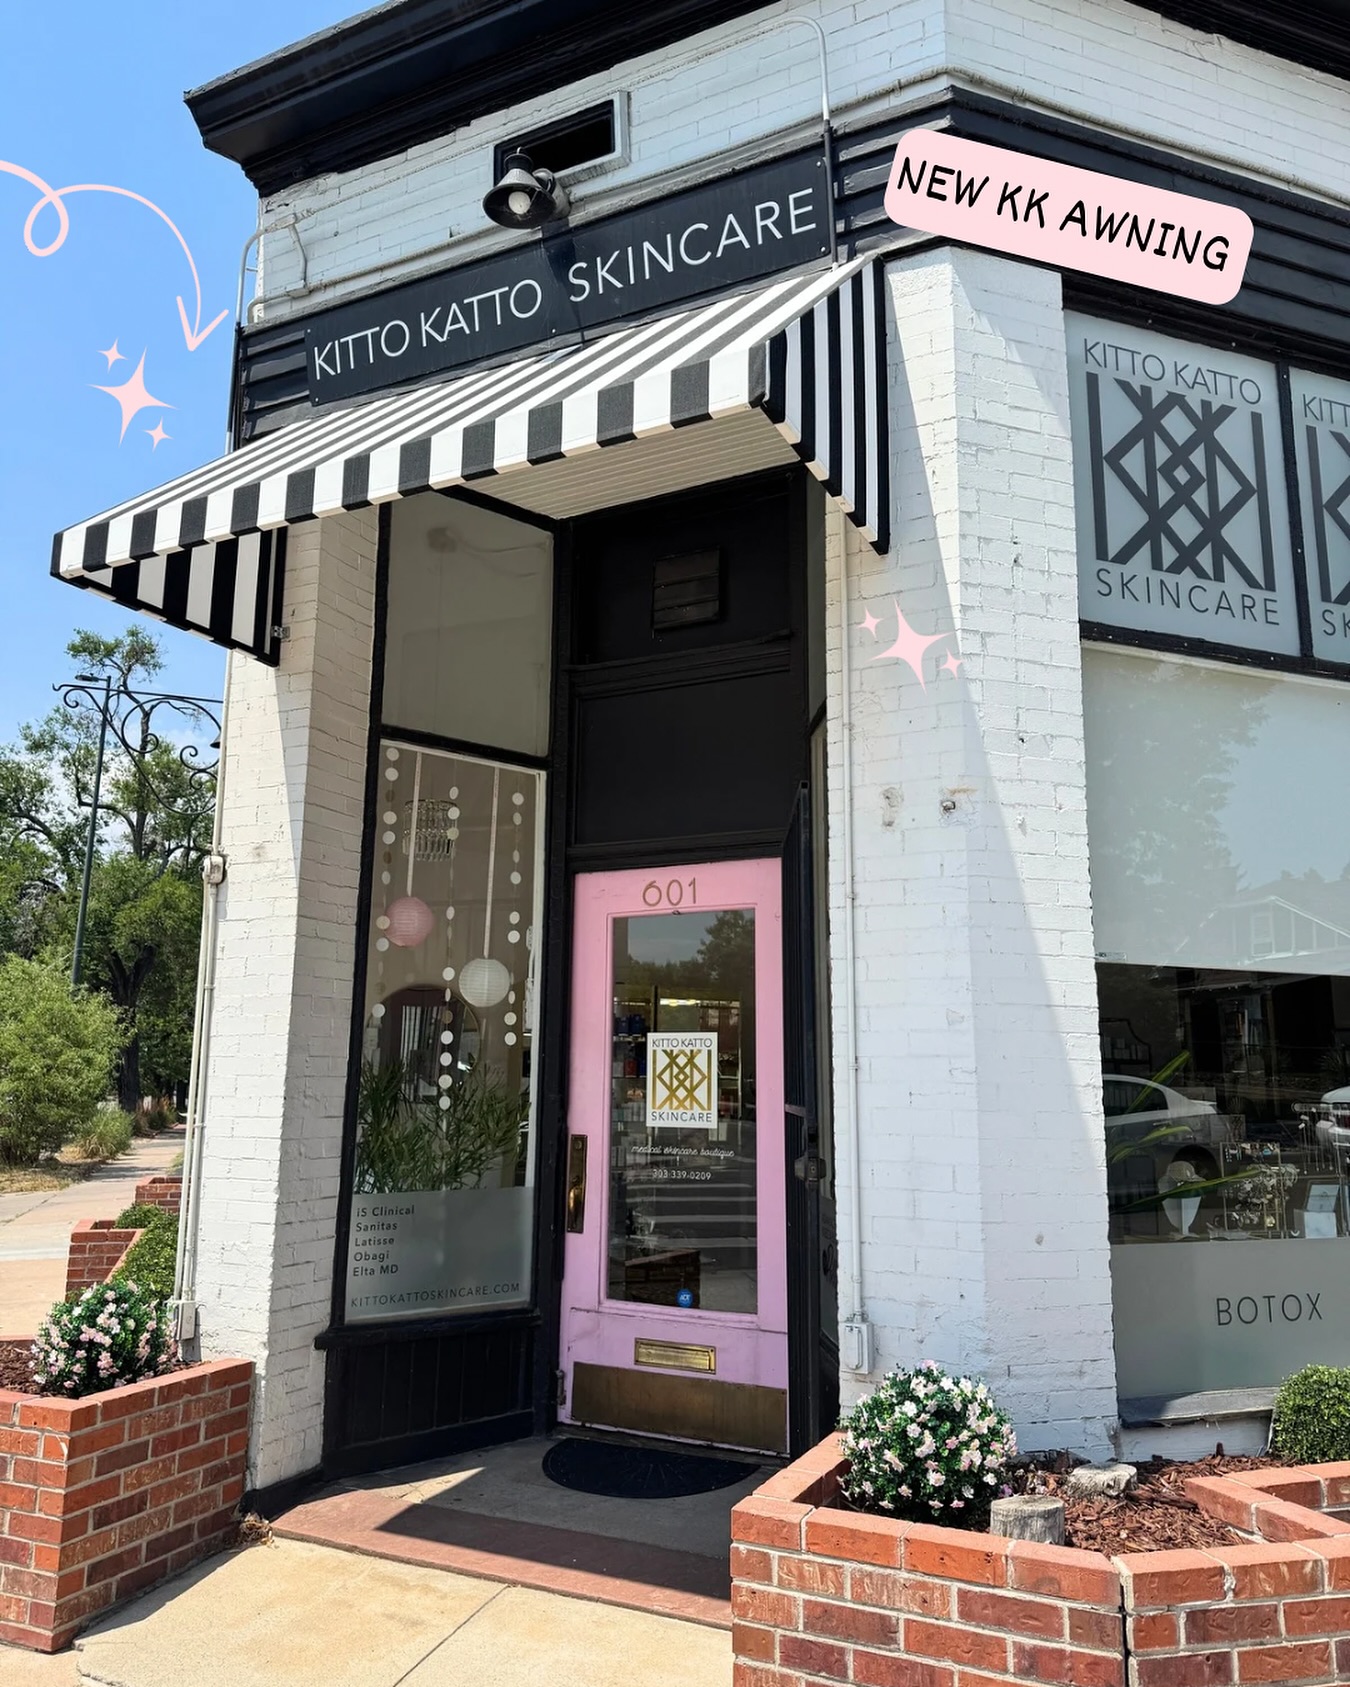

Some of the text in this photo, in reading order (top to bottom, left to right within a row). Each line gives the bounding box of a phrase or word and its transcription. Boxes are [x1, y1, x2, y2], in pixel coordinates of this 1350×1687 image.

[314, 188, 818, 380] KITTO KATTO SKINCARE
[1084, 338, 1262, 405] KITTO KATTO
[1096, 568, 1280, 626] SKINCARE
[642, 877, 696, 907] 601
[652, 1038, 713, 1048] KITTO KATTO
[651, 1111, 712, 1123] SKINCARE
[372, 1204, 415, 1217] Clinical
[355, 1222, 398, 1232] Sanitas
[354, 1236, 395, 1247] Latisse
[353, 1250, 390, 1263] Obagi
[352, 1264, 399, 1277] Elta MD
[351, 1282, 520, 1308] KITTOKATTOSKINCARE.COM
[1216, 1293, 1322, 1326] BOTOX
